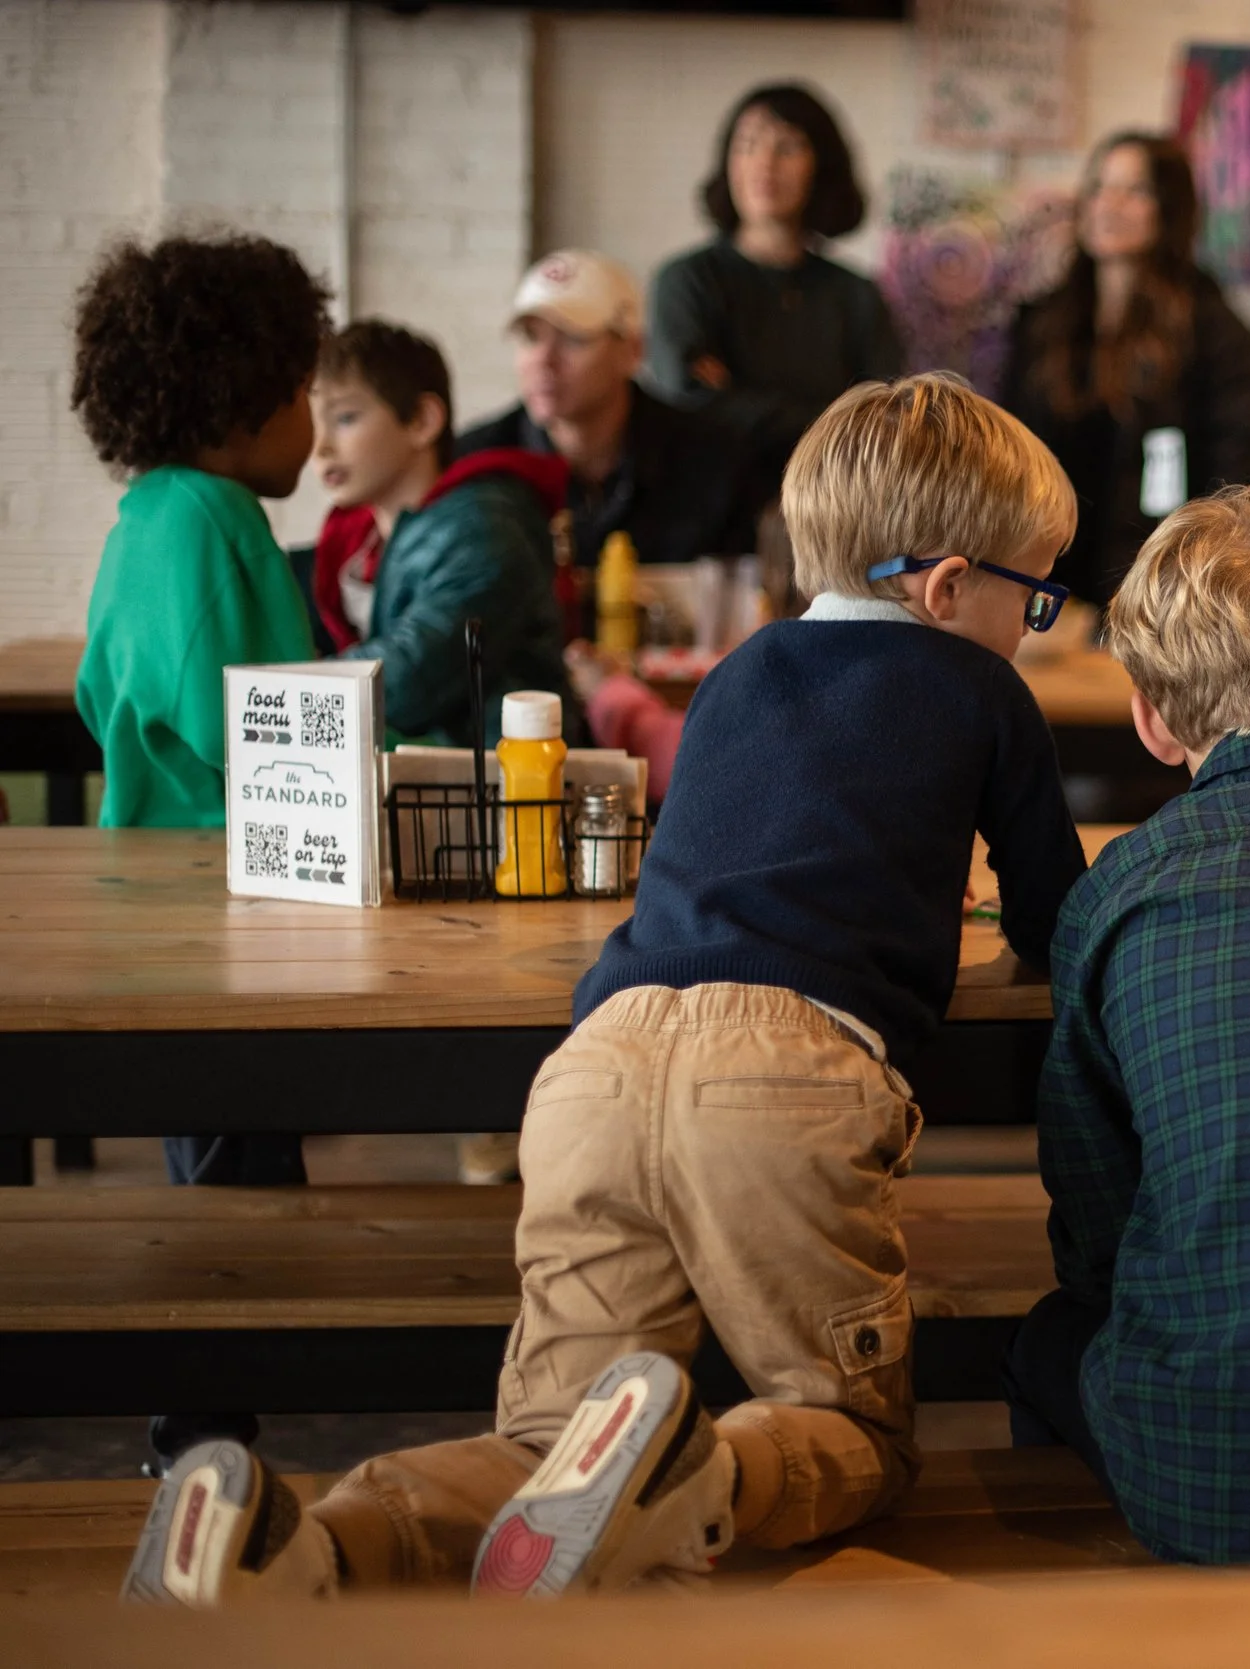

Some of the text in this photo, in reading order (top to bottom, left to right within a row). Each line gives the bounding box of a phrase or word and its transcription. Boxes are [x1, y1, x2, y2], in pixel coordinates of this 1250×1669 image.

[247, 686, 286, 708] food
[243, 710, 291, 727] menu
[286, 772, 301, 784] the
[242, 784, 348, 808] STANDARD
[303, 829, 338, 848] beer
[295, 848, 347, 870] on tap
